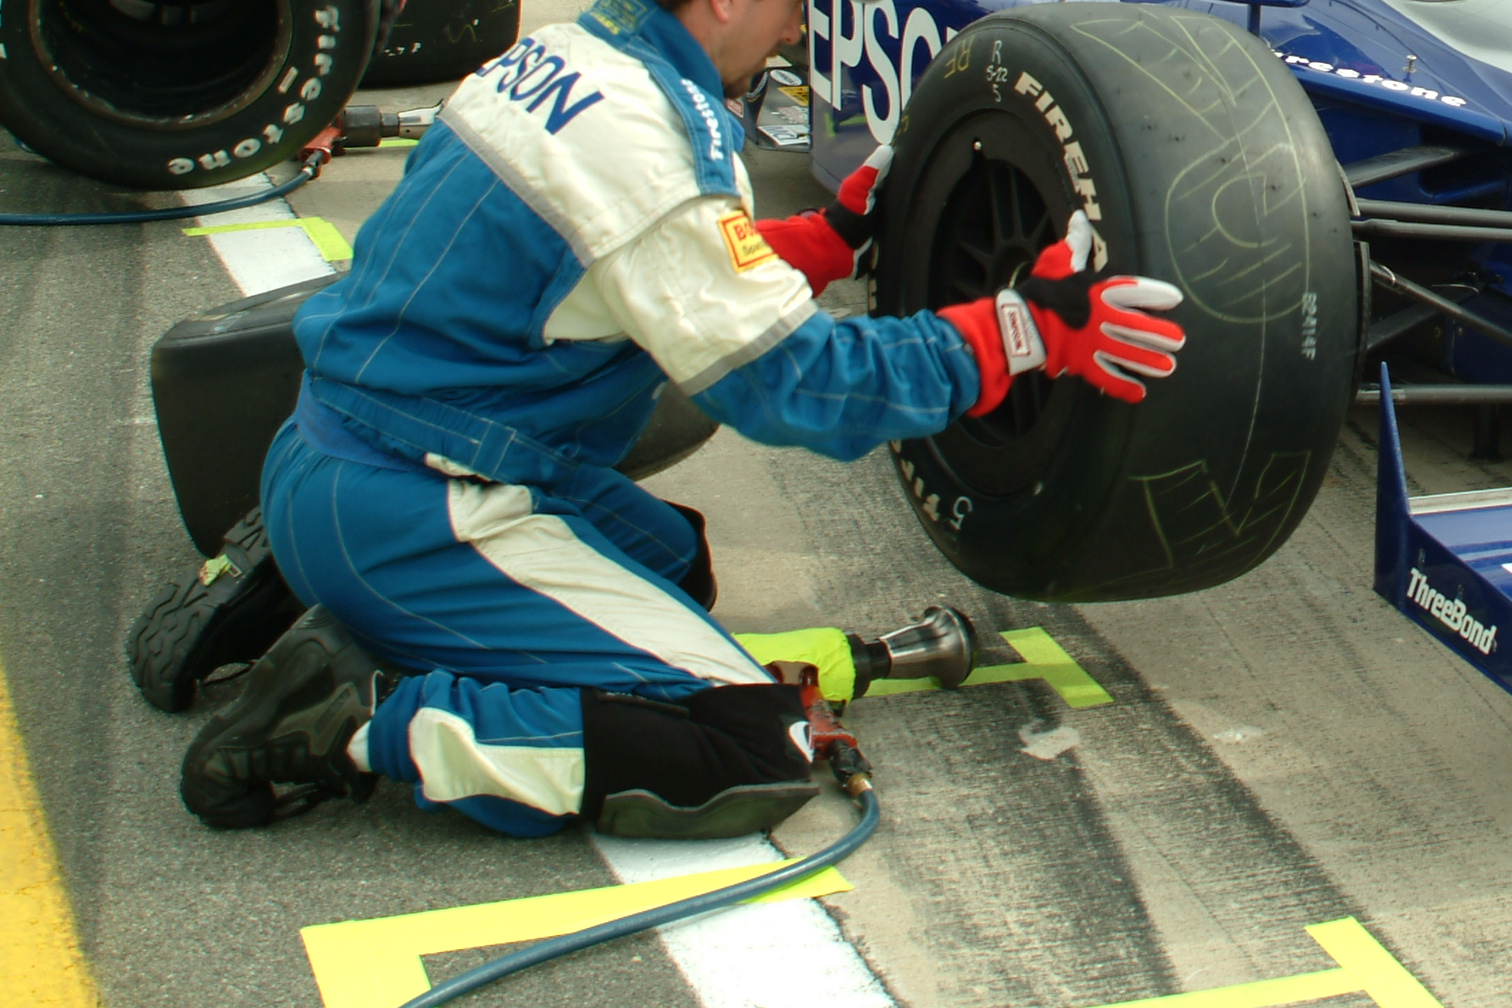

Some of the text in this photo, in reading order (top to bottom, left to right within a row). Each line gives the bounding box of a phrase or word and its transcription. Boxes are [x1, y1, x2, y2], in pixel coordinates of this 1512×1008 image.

[168, 4, 341, 176] Firestone
[475, 37, 606, 136] PSON
[1274, 48, 1467, 107] restone
[1014, 71, 1109, 273] FIREHA
[1406, 567, 1498, 656] ThreeBond
